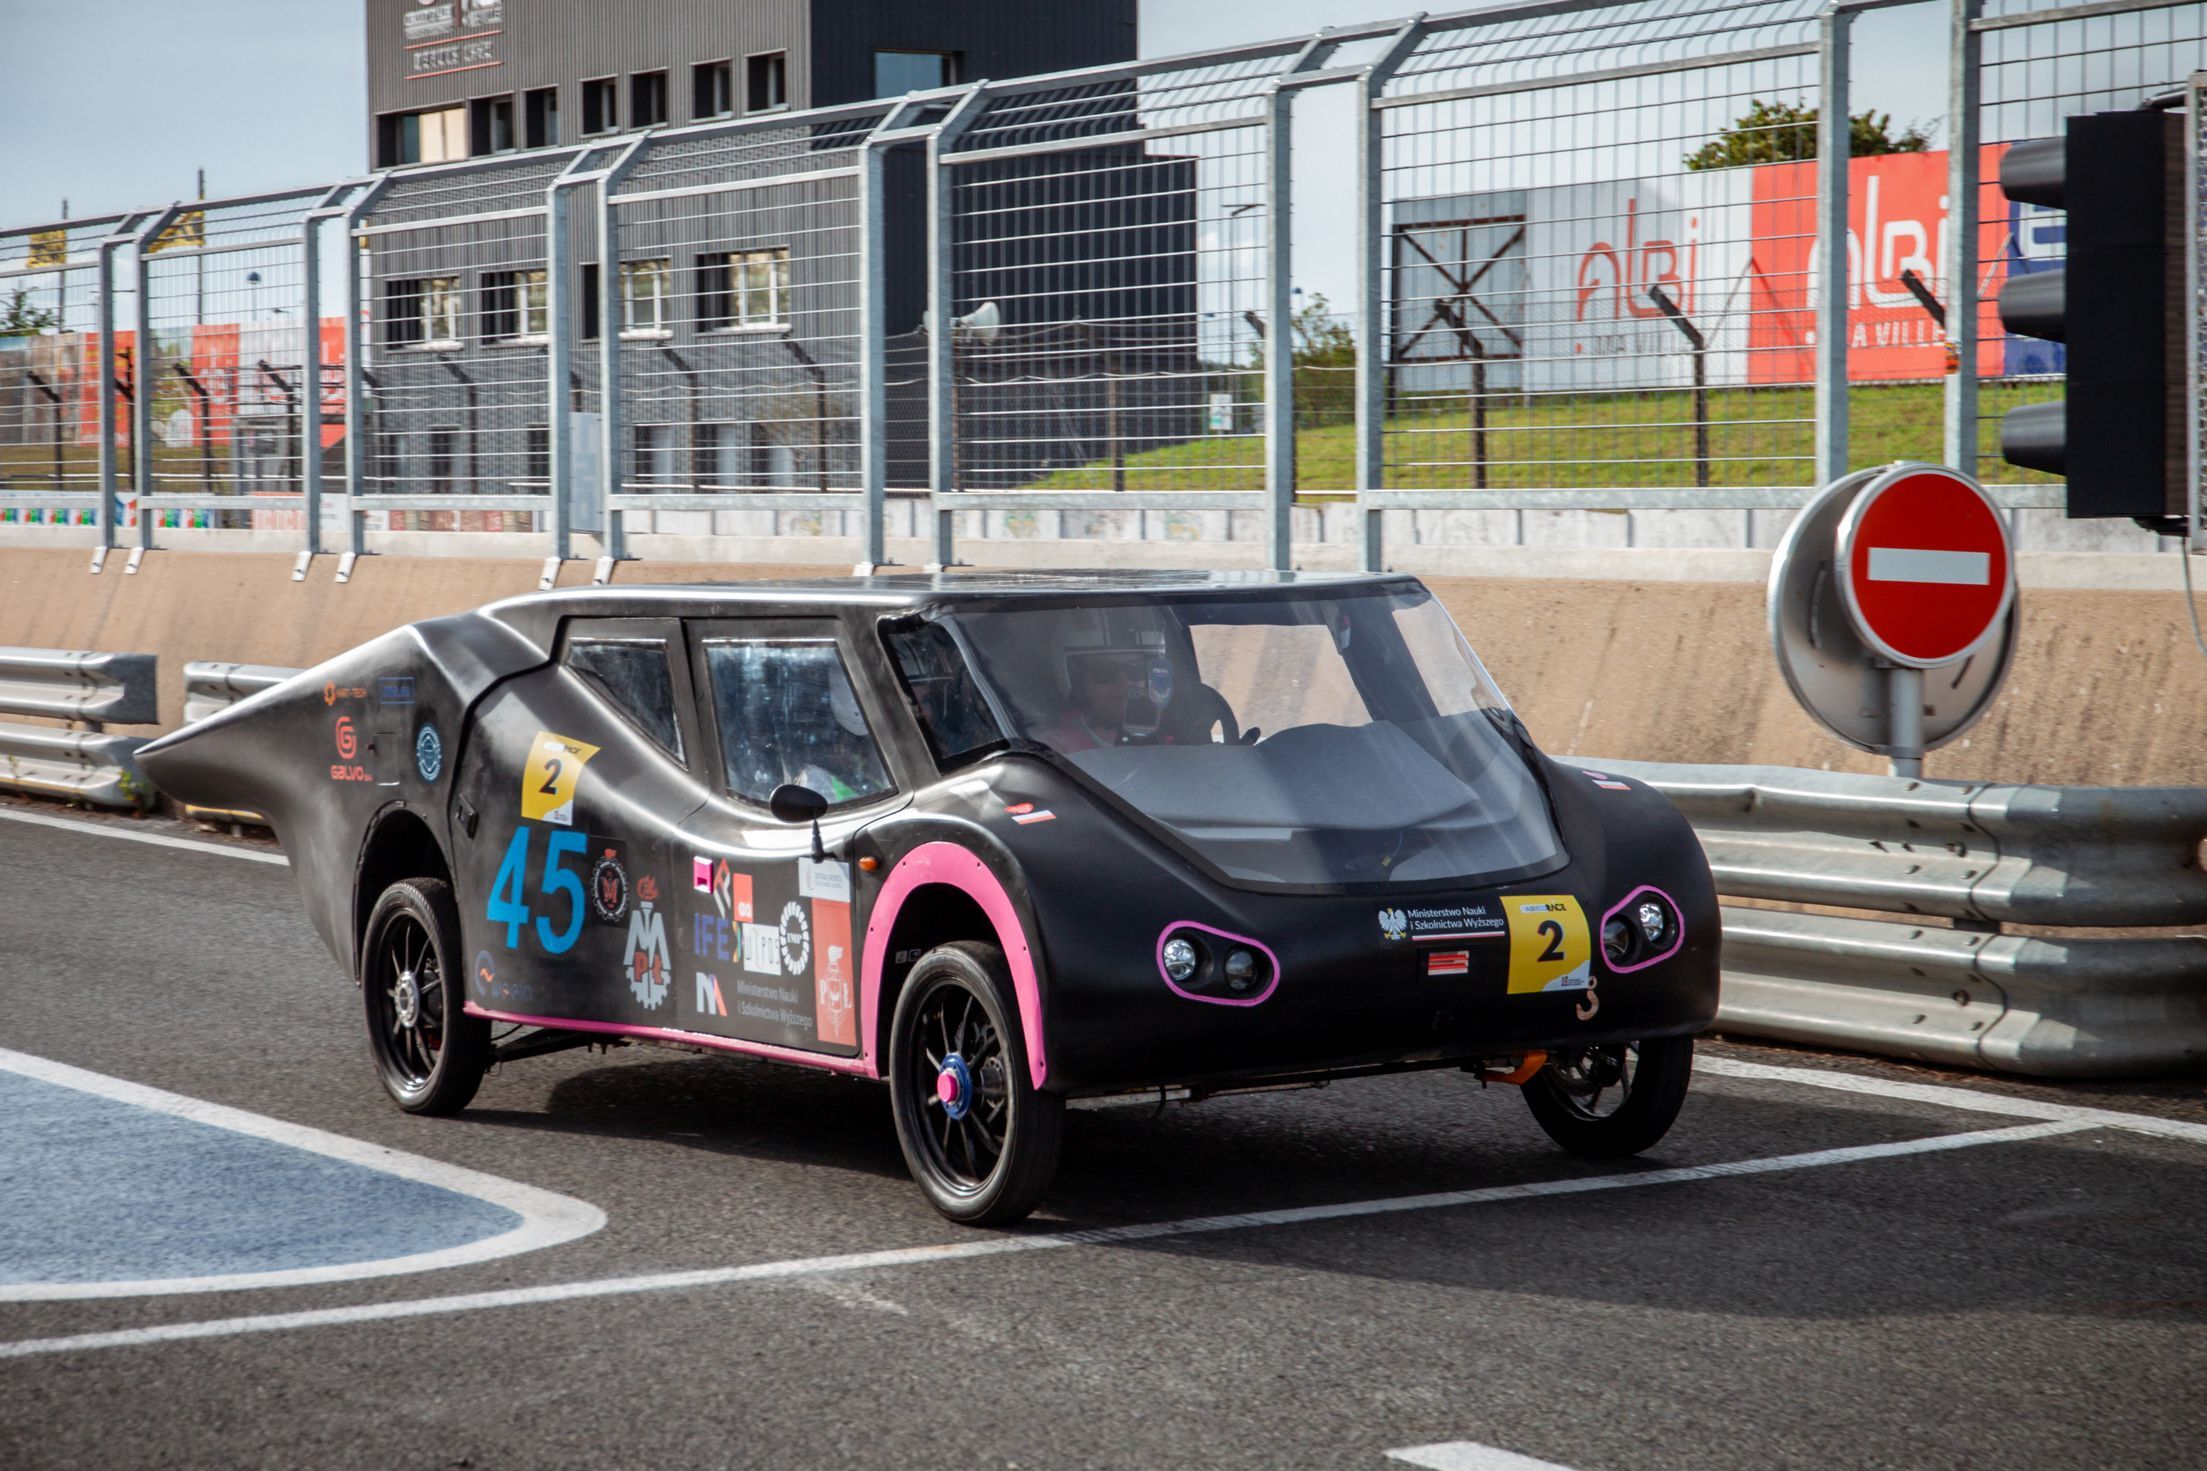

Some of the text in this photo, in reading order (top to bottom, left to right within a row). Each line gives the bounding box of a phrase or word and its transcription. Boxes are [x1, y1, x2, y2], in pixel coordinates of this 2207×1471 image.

[539, 758, 562, 795] 2
[486, 826, 588, 954] 45
[1407, 906, 1486, 919] Ministerstwo Nauki
[1415, 919, 1463, 931] Szkolnictwa
[1464, 917, 1504, 930] Wyższego
[1536, 919, 1565, 963] 2
[737, 979, 799, 1003] Ministerstwo Nauki
[741, 1001, 779, 1022] Szkolnictwa
